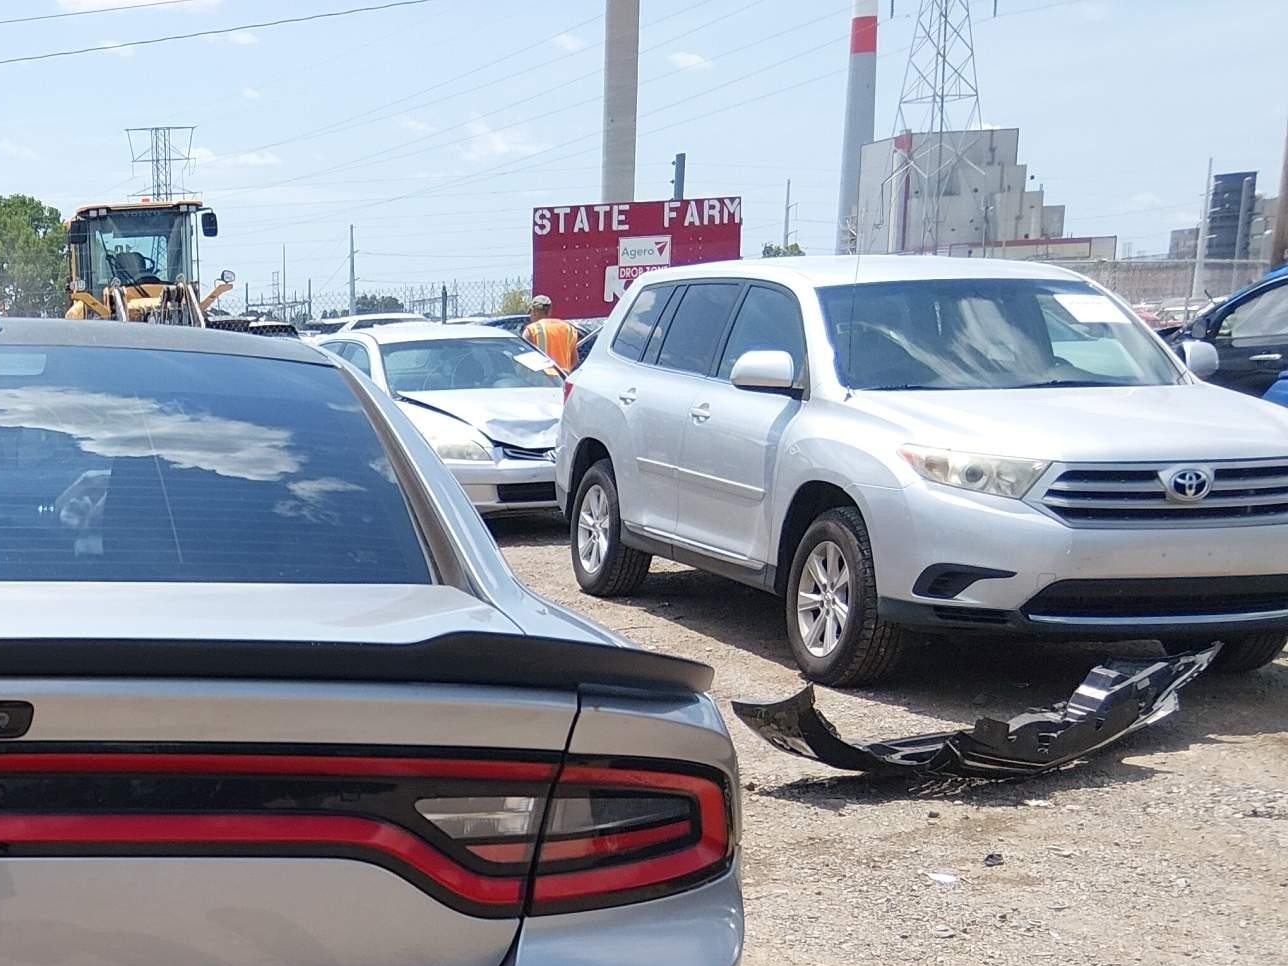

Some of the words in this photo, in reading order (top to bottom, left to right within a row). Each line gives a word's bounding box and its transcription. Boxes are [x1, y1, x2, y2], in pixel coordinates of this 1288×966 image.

[534, 204, 630, 235] STATE
[663, 198, 741, 228] FARM
[621, 247, 655, 260] Agero
[619, 266, 644, 279] DROP
